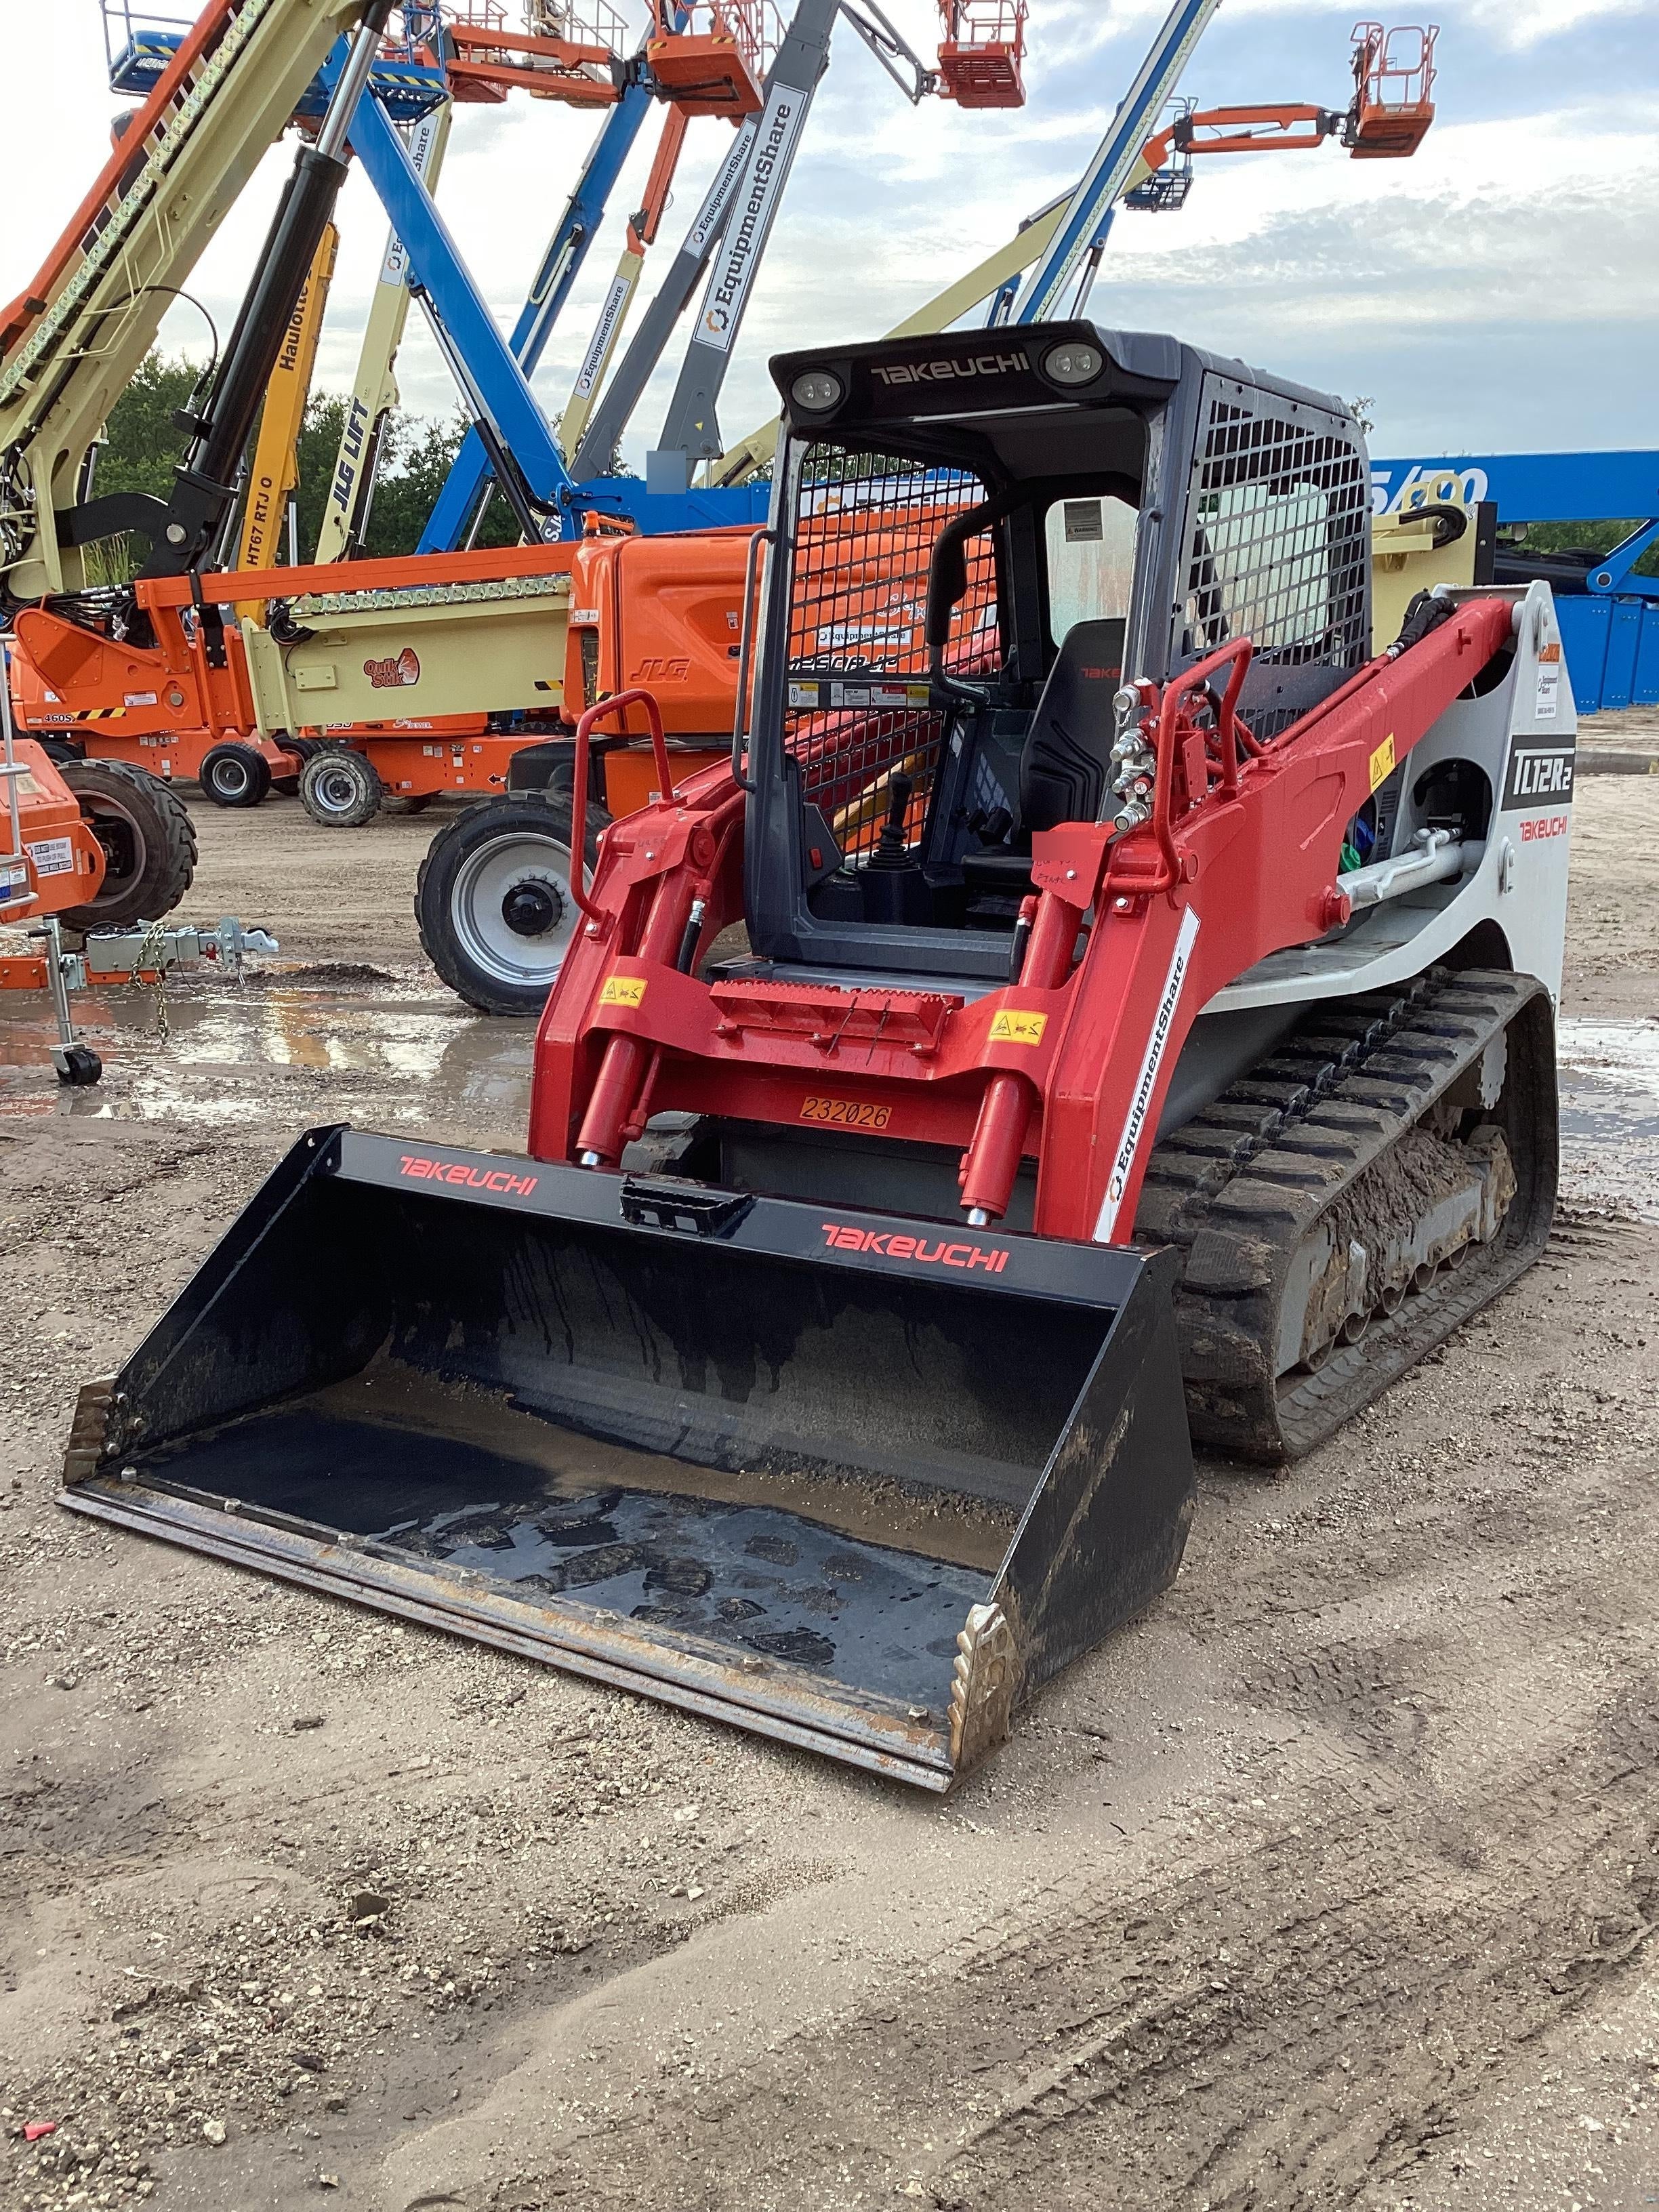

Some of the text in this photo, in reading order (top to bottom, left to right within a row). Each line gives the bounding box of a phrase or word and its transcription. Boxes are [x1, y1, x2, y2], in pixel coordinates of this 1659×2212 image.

[699, 134, 752, 231] EquipmentShare
[715, 104, 792, 306] EquipmentShare
[584, 286, 623, 378] EquipmentShare
[333, 396, 369, 514] JLG LIFT
[254, 491, 270, 523] RTJ
[246, 525, 264, 566] HT67
[365, 659, 399, 675] Quik
[373, 672, 405, 687] Stik
[630, 656, 692, 683] JLG
[1117, 954, 1184, 1175] EquipmentShare
[802, 1097, 889, 1128] 232026
